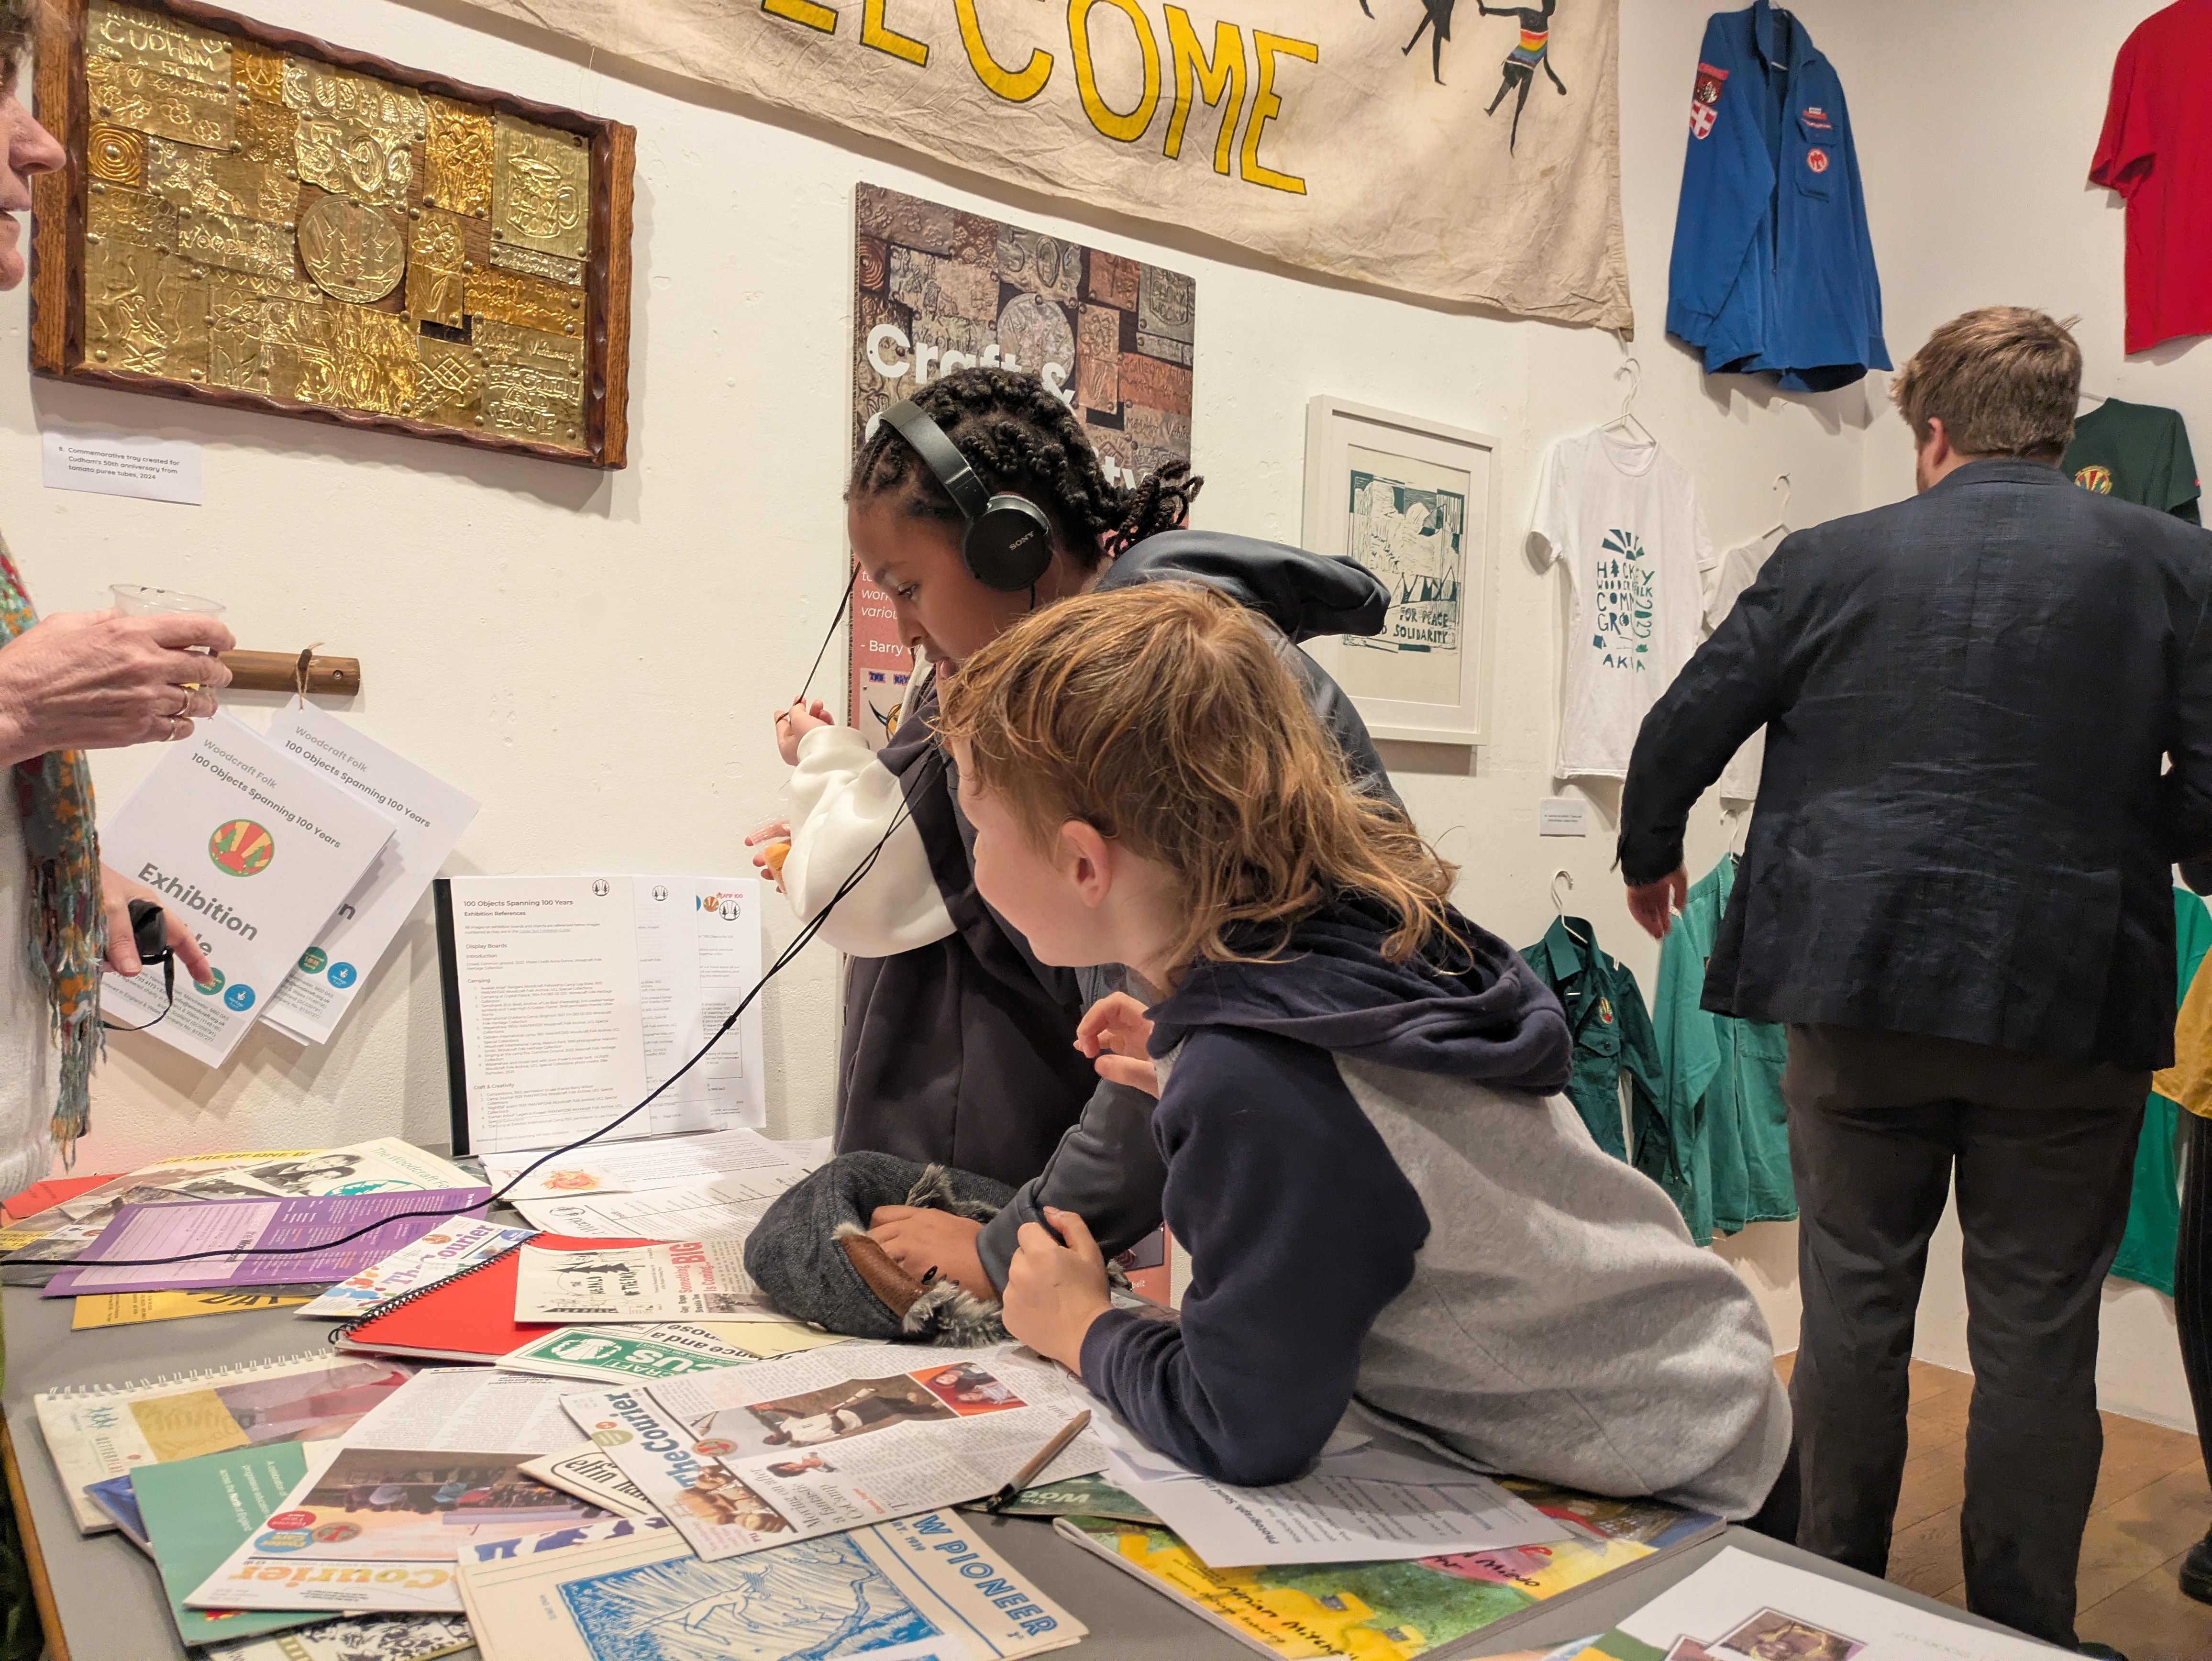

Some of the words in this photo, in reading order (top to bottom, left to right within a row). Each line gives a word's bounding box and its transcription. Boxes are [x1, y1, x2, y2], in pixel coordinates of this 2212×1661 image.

[762, 0, 1319, 195] LCOME
[68, 448, 124, 459] Commemorative
[68, 456, 101, 465] Cudham's
[121, 463, 160, 473] anniversary
[1009, 531, 1036, 550] SONY
[862, 589, 893, 602] wor
[1400, 607, 1418, 622] FOR
[1422, 610, 1448, 628] PEACE
[1393, 624, 1448, 644] SOLIDARITY
[869, 640, 903, 657] Barry
[296, 726, 347, 760] Woodcraft
[347, 756, 368, 772] Folk
[203, 739, 256, 776] Woodcraft
[256, 771, 278, 789] Folk
[285, 740, 302, 754] 100
[303, 751, 339, 776] Objects
[341, 772, 387, 804] Spanning
[387, 798, 403, 811] 100
[404, 808, 431, 827] Years
[192, 753, 210, 767] 100
[210, 764, 248, 791] Objects
[248, 788, 295, 822] Spanning
[295, 817, 312, 831] 100
[313, 827, 340, 848] Years
[137, 862, 259, 941] Exhibition
[370, 1147, 389, 1158] The
[389, 1155, 439, 1184] Woodcraft
[669, 1242, 706, 1264] BIG
[675, 1265, 693, 1293] Something
[664, 1334, 708, 1351] and
[564, 1453, 618, 1483] elfin
[228, 1564, 454, 1590] Courier
[933, 1539, 1058, 1637] PIONEER
